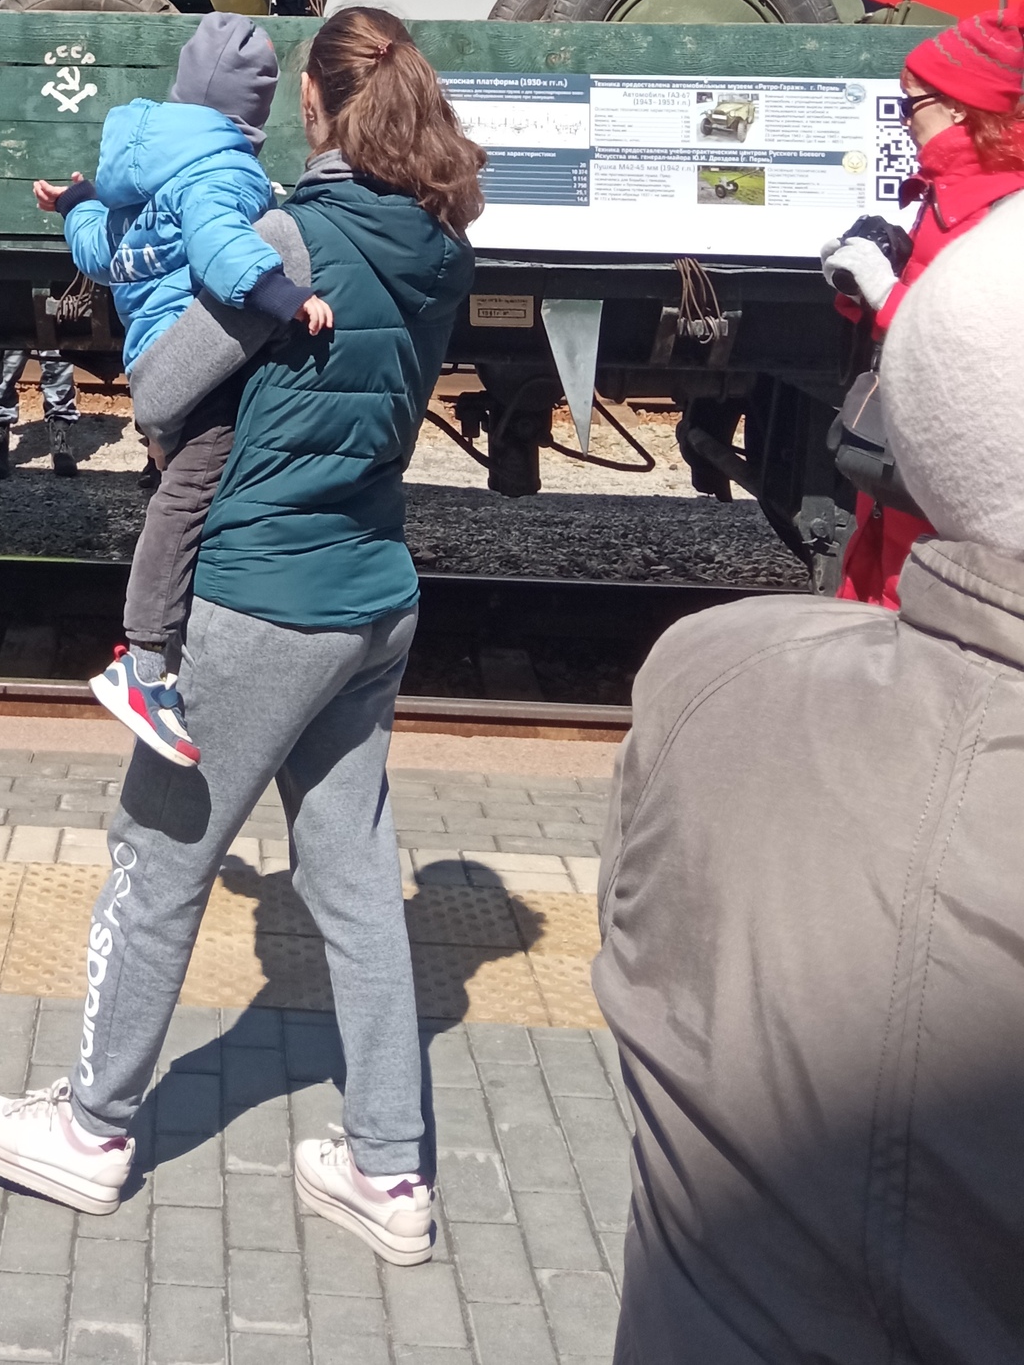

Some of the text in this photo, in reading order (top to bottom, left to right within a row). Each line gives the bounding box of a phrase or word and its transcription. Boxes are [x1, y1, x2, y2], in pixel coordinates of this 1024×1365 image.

[44, 45, 96, 65] СССР
[476, 78, 519, 87] платформа
[817, 84, 840, 92] Пермь
